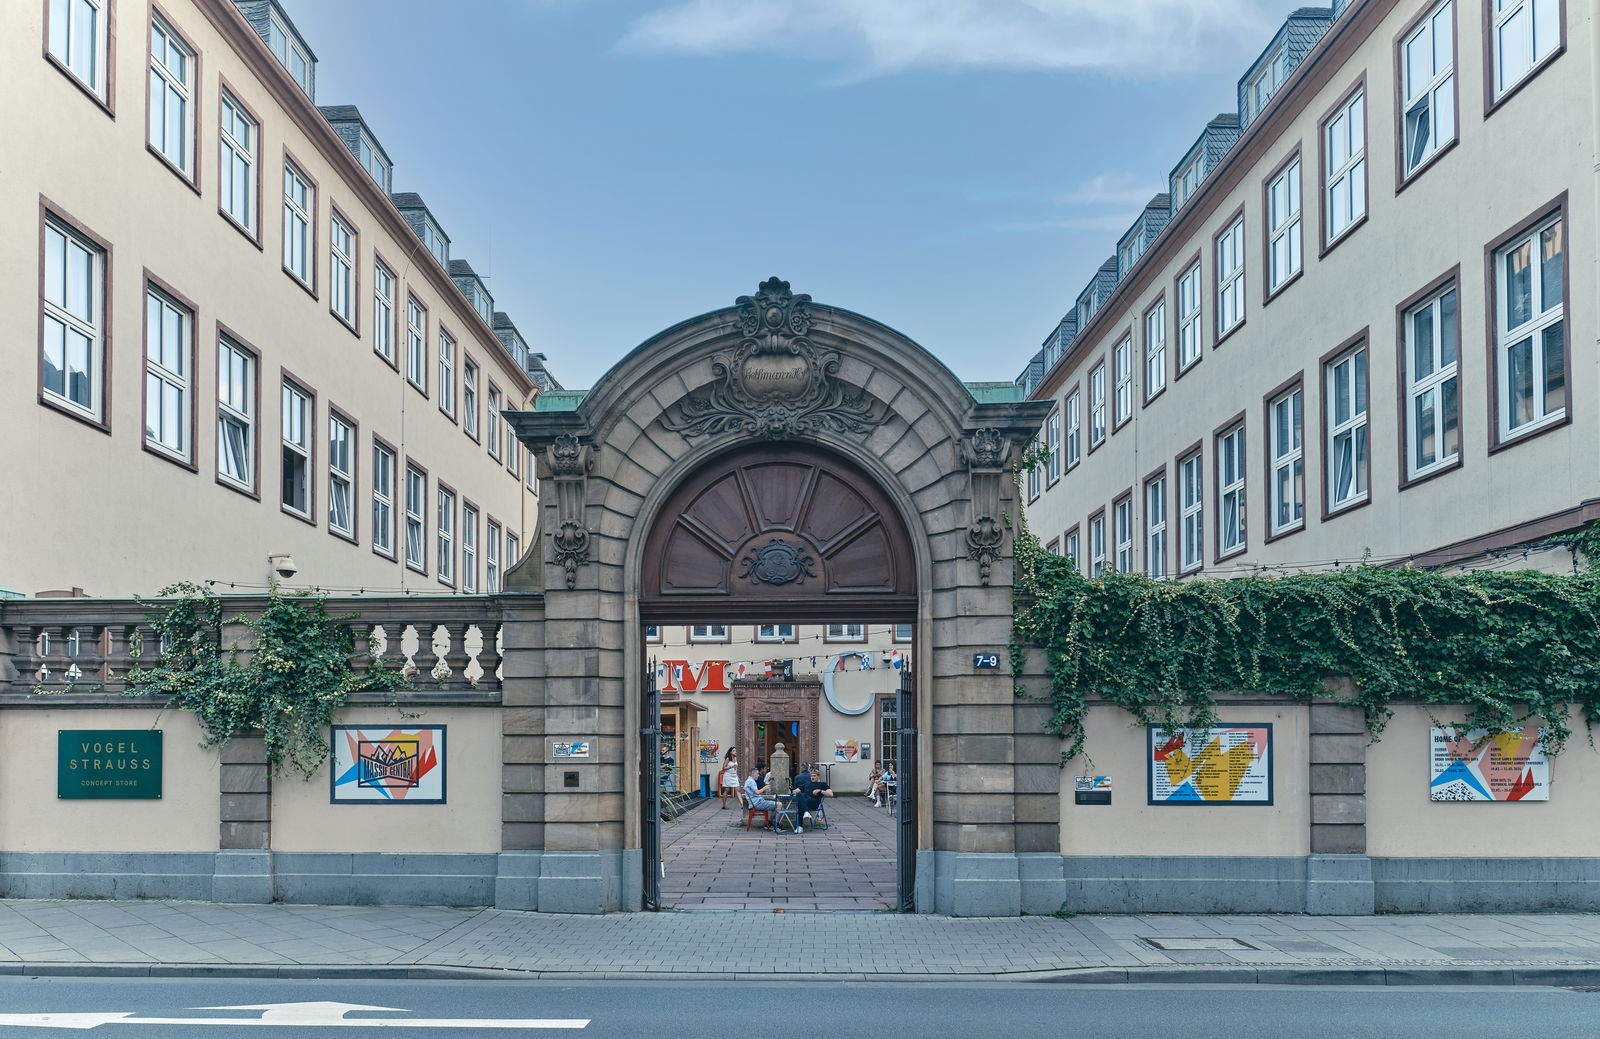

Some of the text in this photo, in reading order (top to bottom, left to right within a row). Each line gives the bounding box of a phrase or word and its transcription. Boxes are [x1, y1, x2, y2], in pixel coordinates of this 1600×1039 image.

[976, 655, 997, 667] 7-9
[1434, 735, 1452, 743] HOME
[81, 742, 138, 754] VOGEL
[69, 758, 151, 770] STRAUSS
[363, 758, 415, 781] MASSIF CENTRAL
